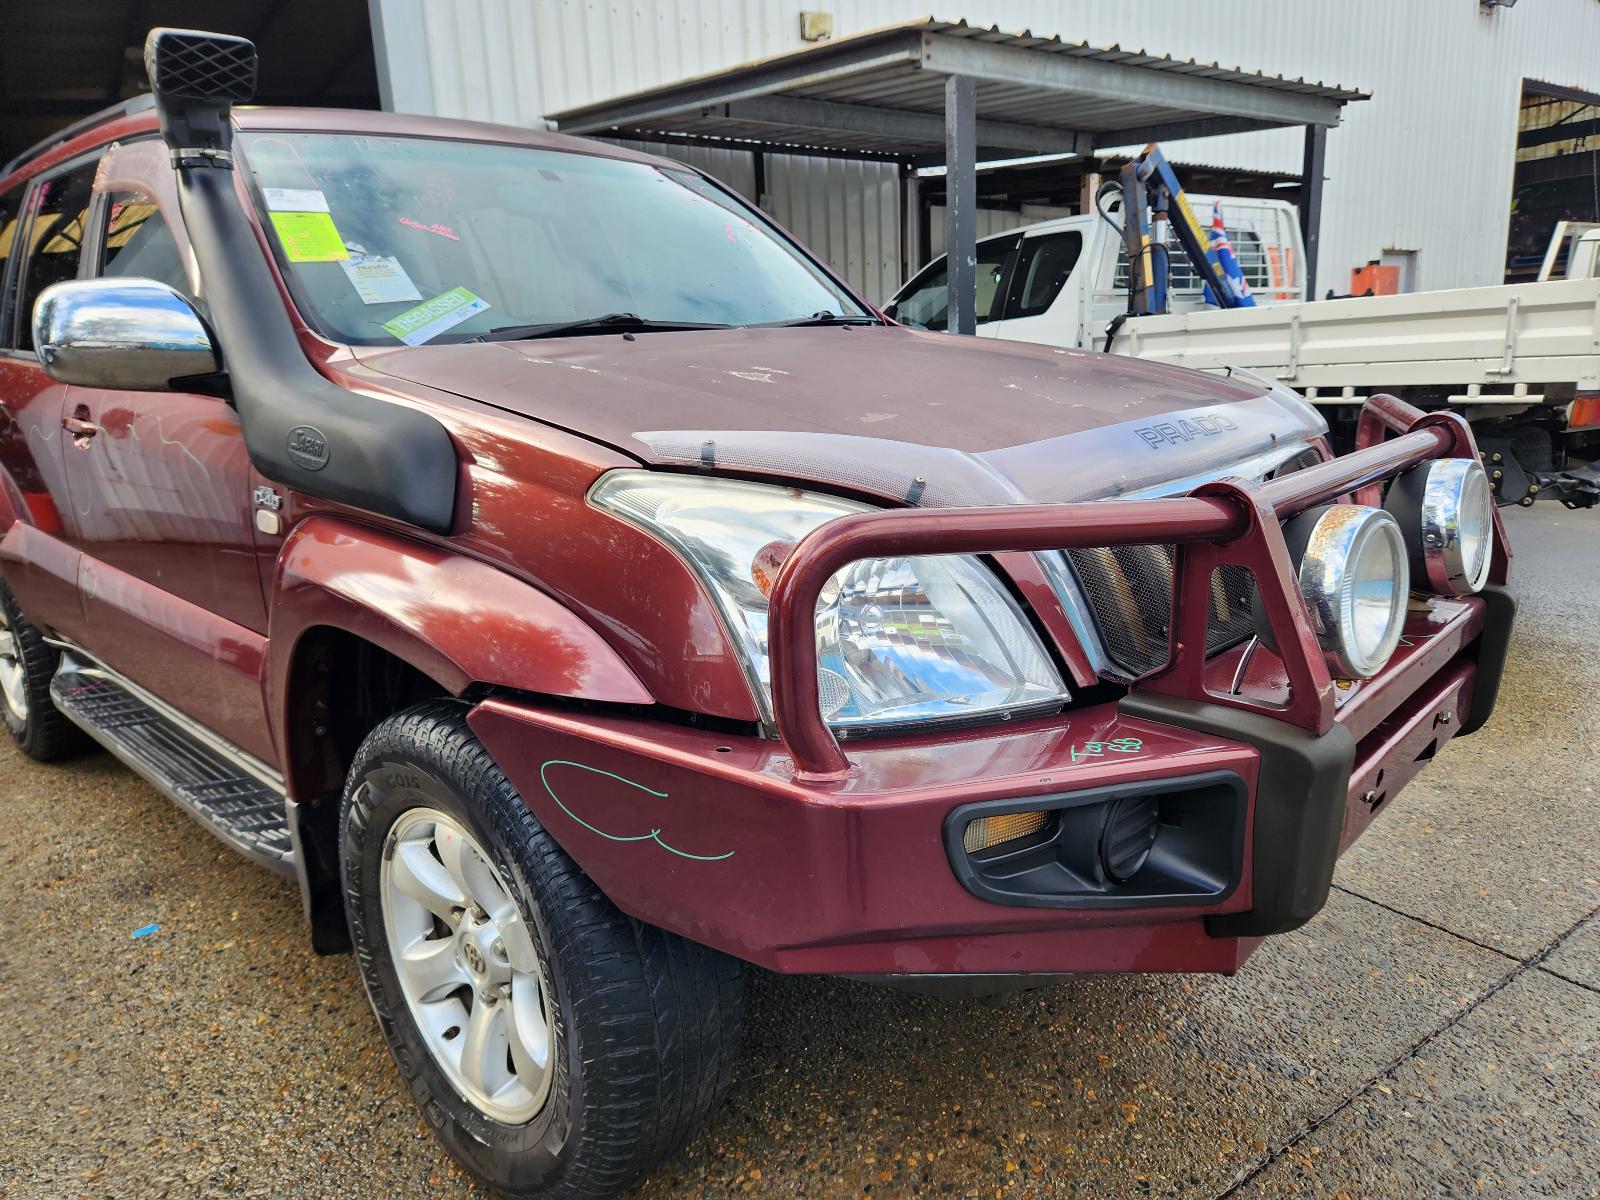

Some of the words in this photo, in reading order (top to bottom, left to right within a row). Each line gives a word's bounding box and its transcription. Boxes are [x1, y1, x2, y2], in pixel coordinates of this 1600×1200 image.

[396, 292, 467, 333] DEGASSED
[290, 431, 324, 456] SAFARI
[1134, 413, 1238, 449] PRADO
